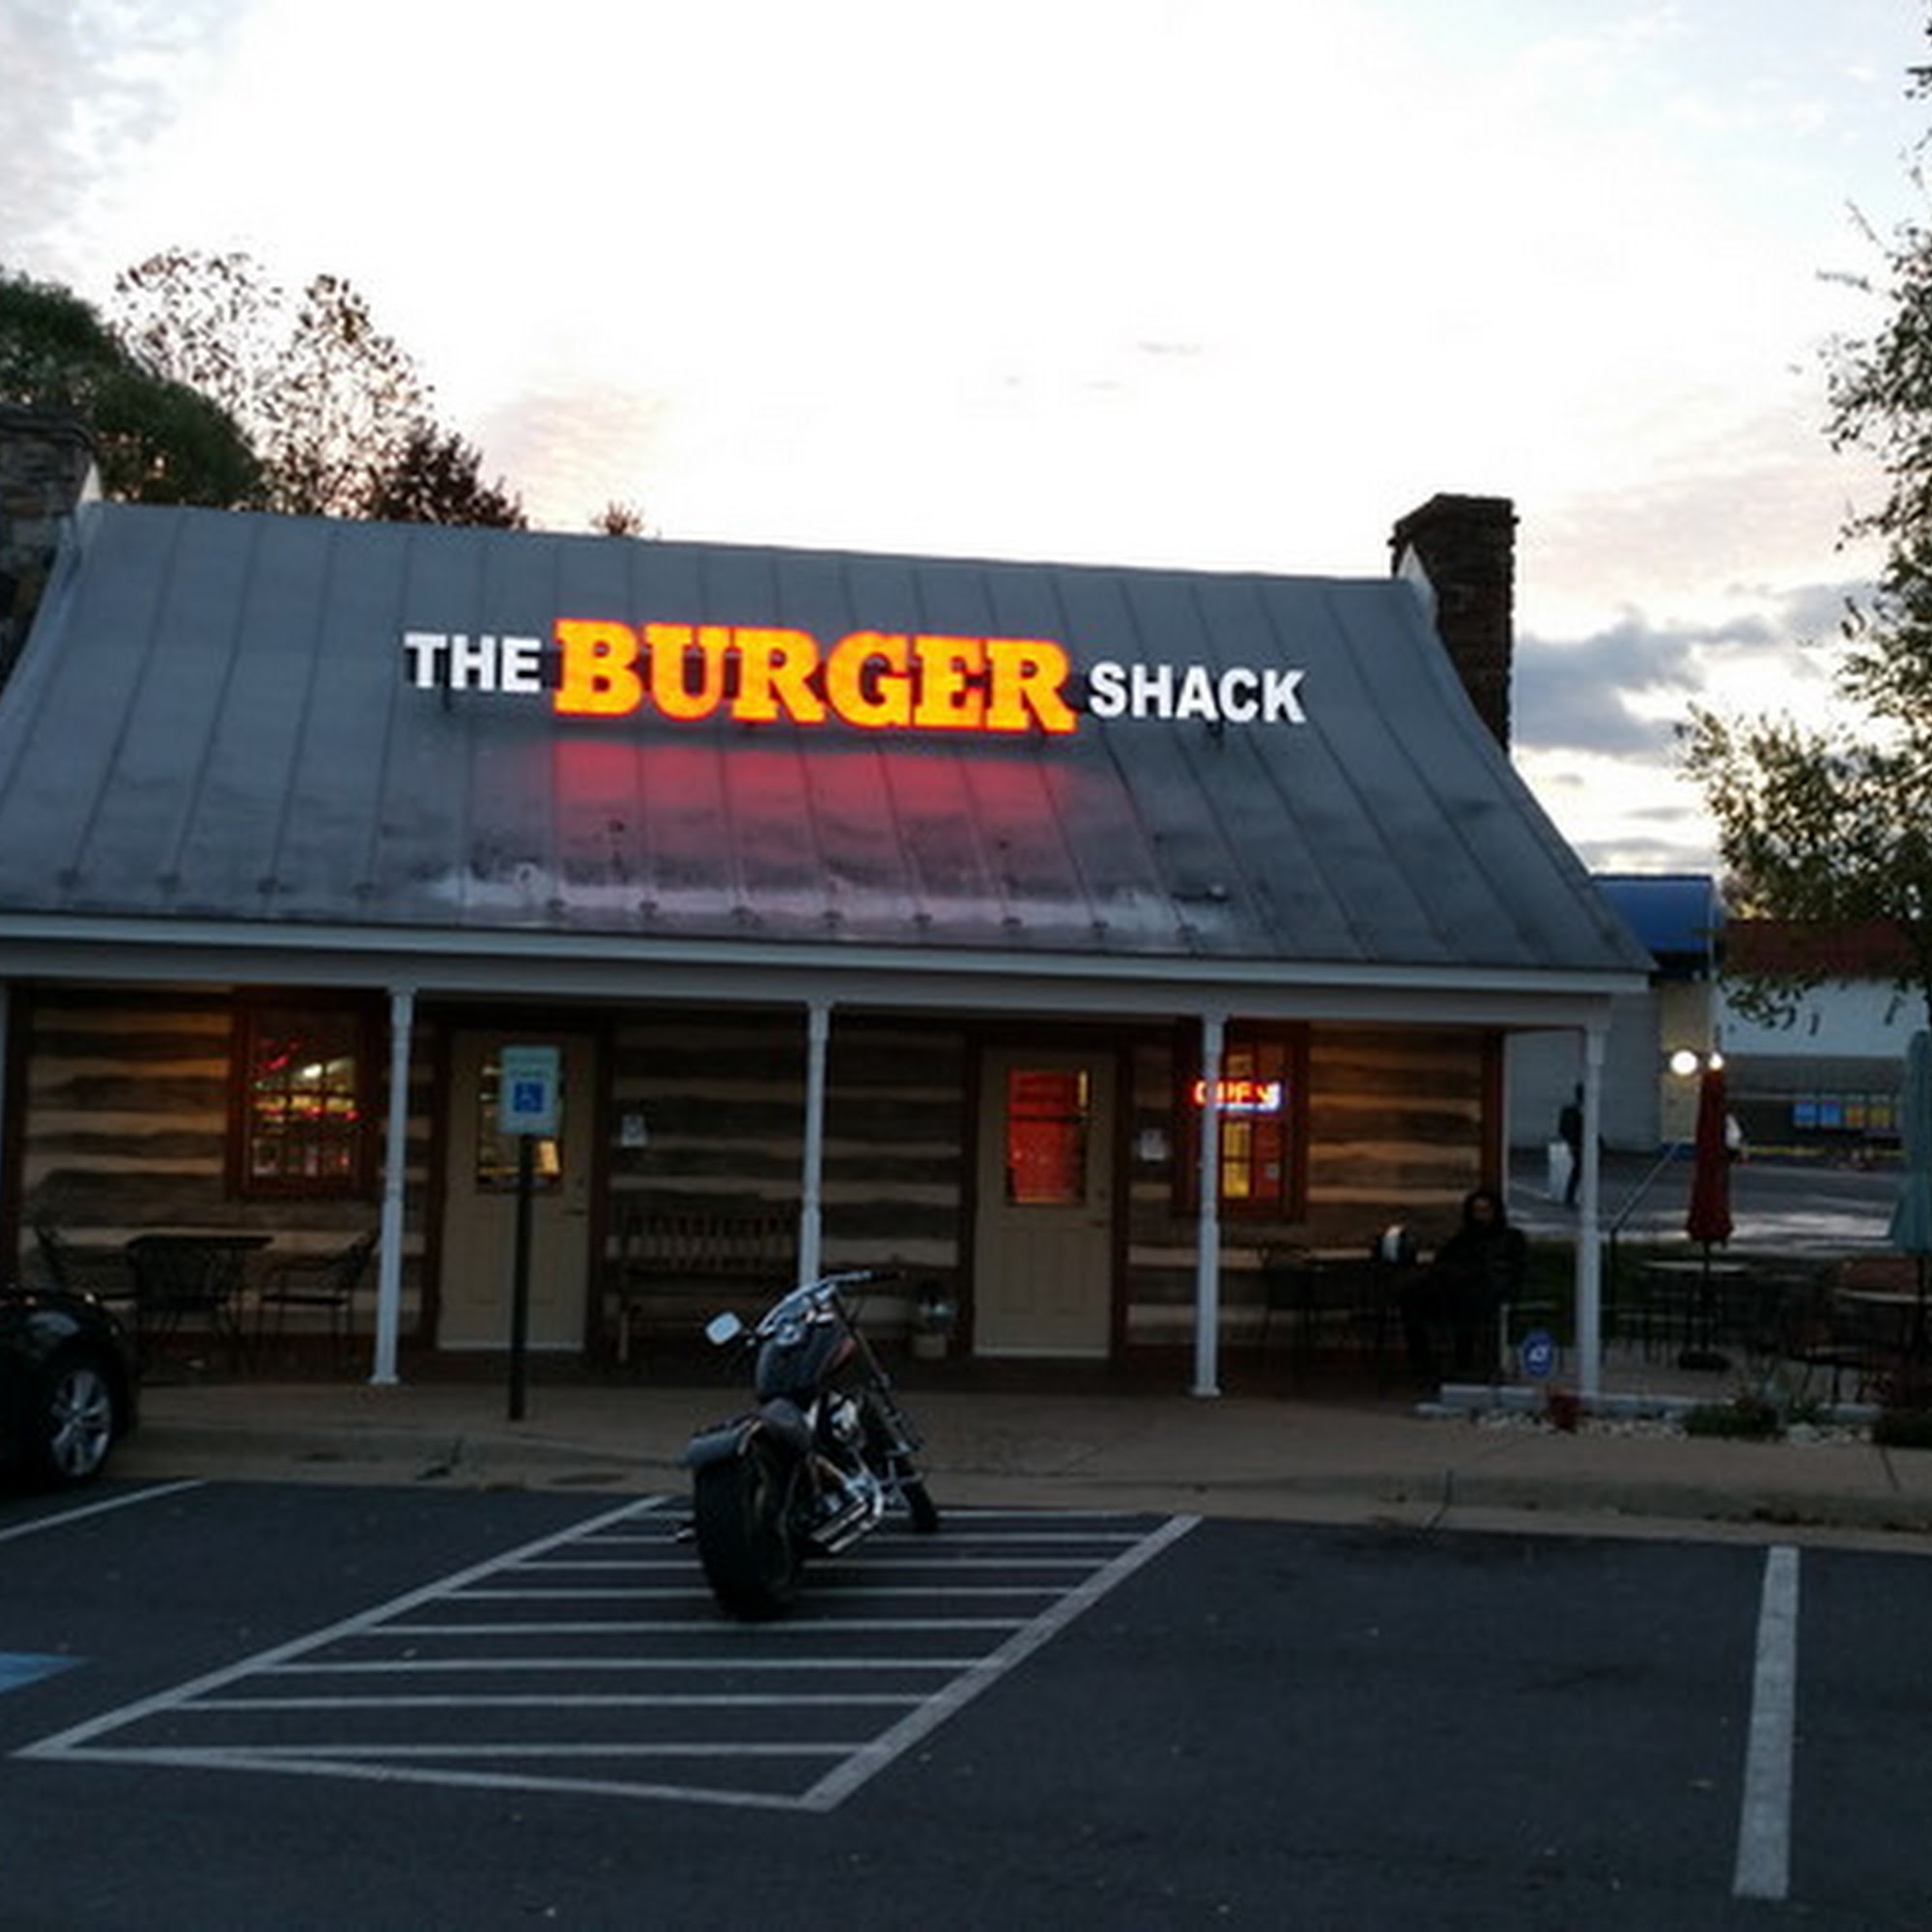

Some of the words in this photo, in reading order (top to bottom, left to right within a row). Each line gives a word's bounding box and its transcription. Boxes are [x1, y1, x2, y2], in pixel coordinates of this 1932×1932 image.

[404, 632, 542, 693] THE
[554, 618, 1077, 733] BURGER
[1089, 661, 1306, 724] SHACK
